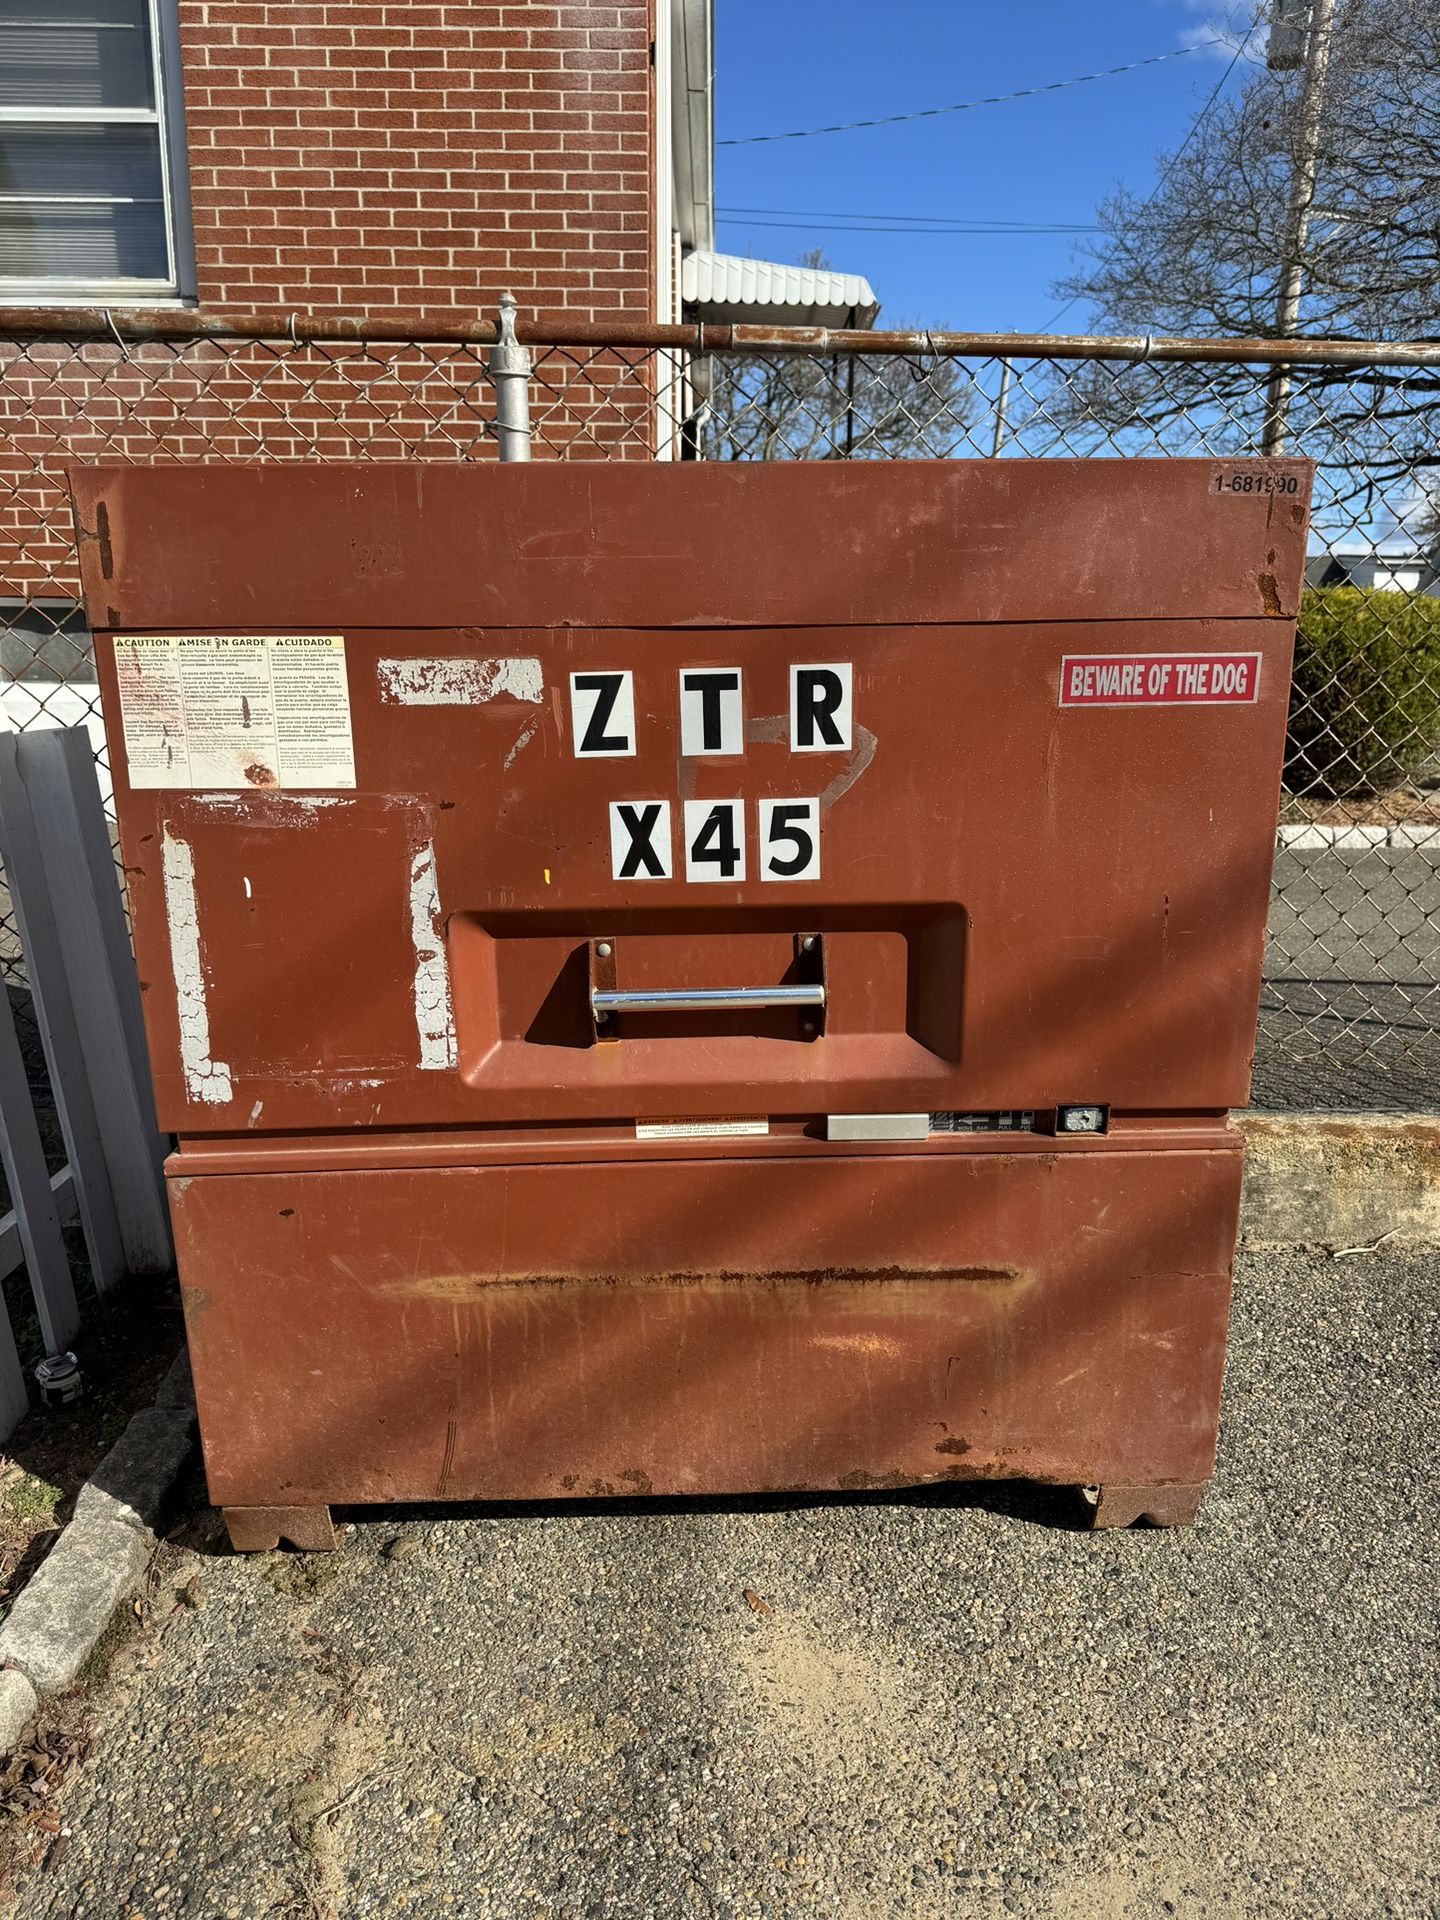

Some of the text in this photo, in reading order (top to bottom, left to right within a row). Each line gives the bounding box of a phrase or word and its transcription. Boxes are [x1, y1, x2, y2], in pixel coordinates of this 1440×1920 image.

[1215, 474, 1298, 494] 1-681990
[124, 639, 170, 647] CAUTION
[1070, 662, 1248, 697] BEWARE OF THE DOG
